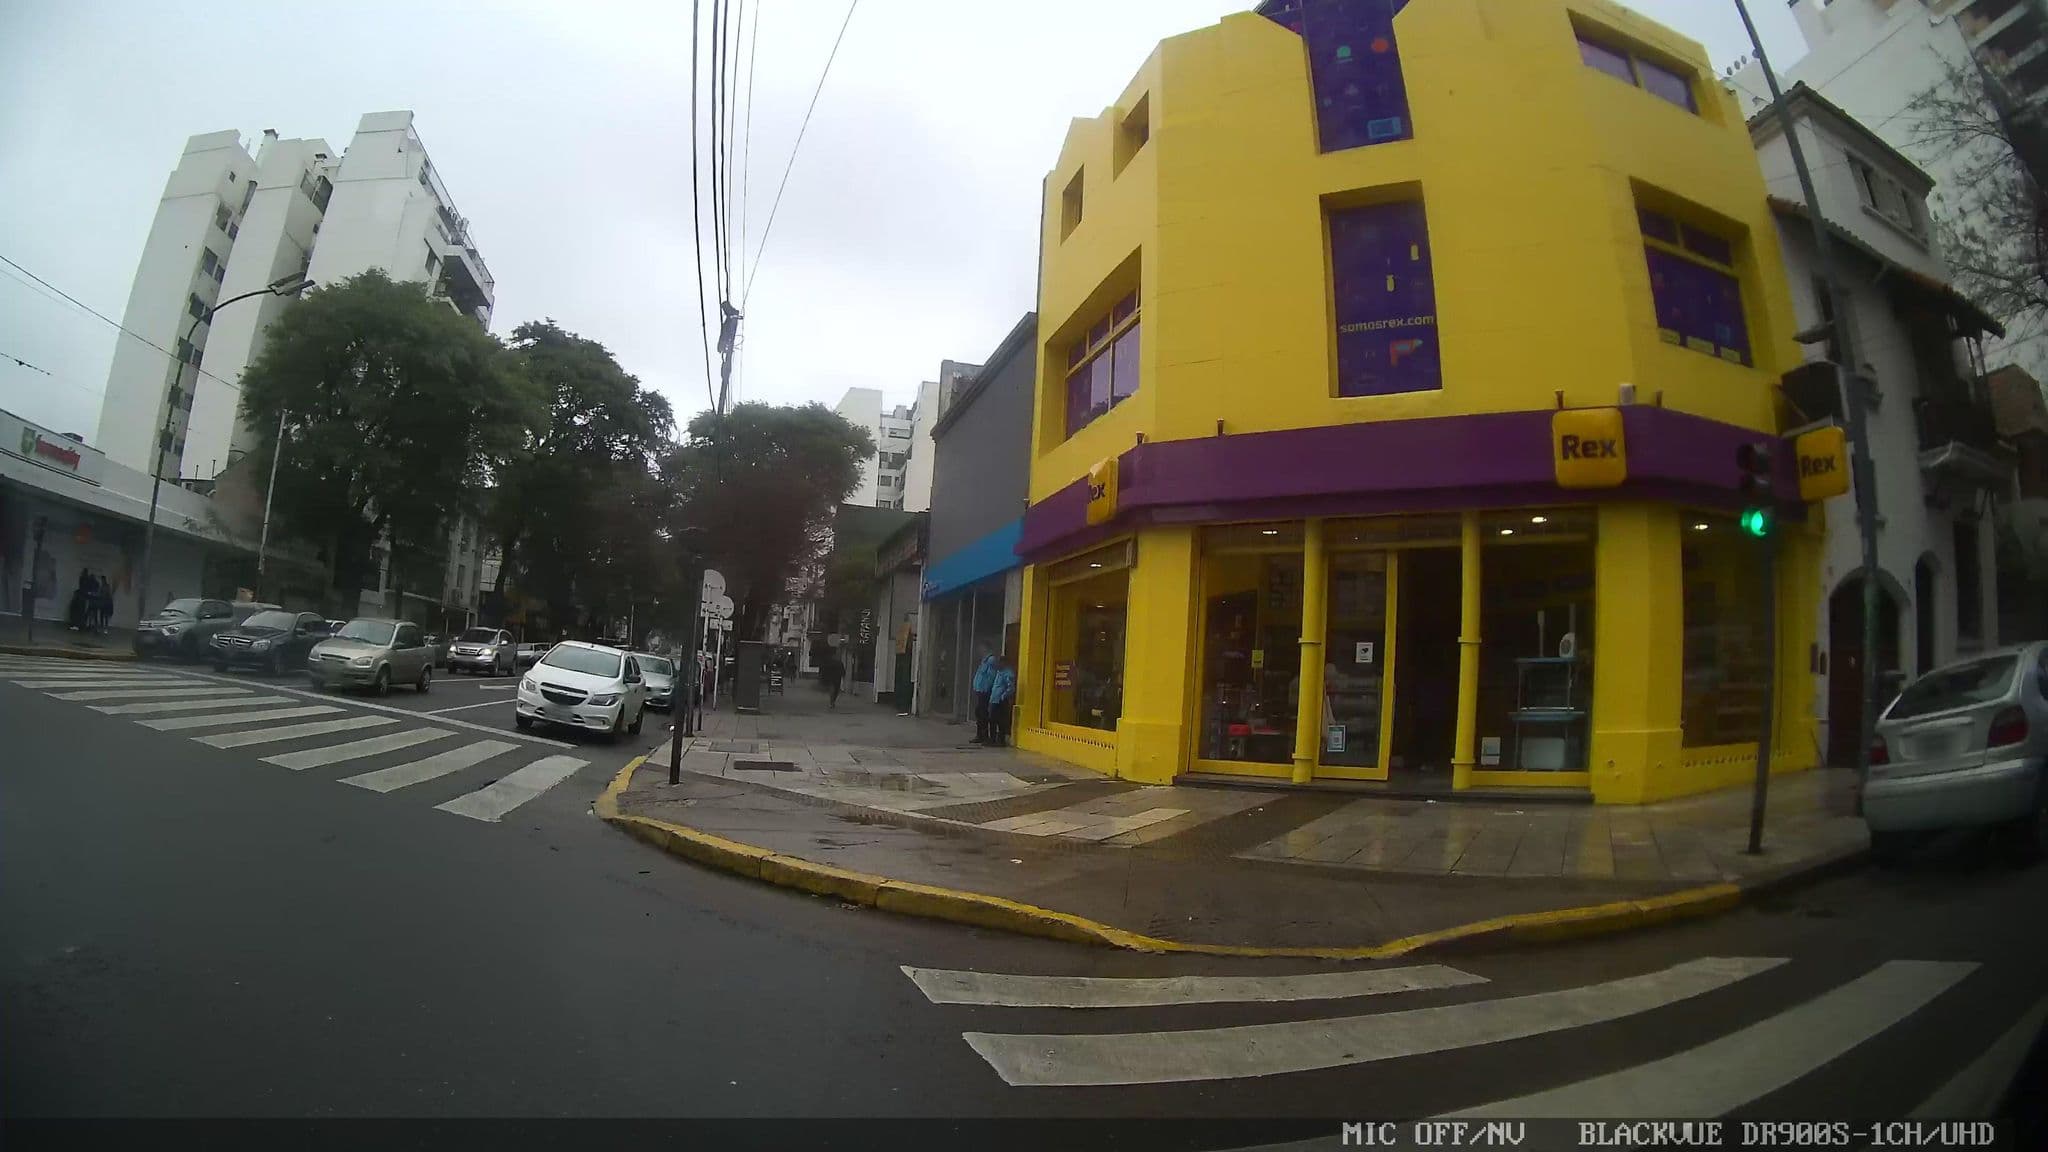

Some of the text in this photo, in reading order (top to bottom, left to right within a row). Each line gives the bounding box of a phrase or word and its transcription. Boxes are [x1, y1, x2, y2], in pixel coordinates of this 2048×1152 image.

[1340, 315, 1434, 333] somosrex.com
[1561, 435, 1617, 461] Rex
[1801, 454, 1837, 478] Rex
